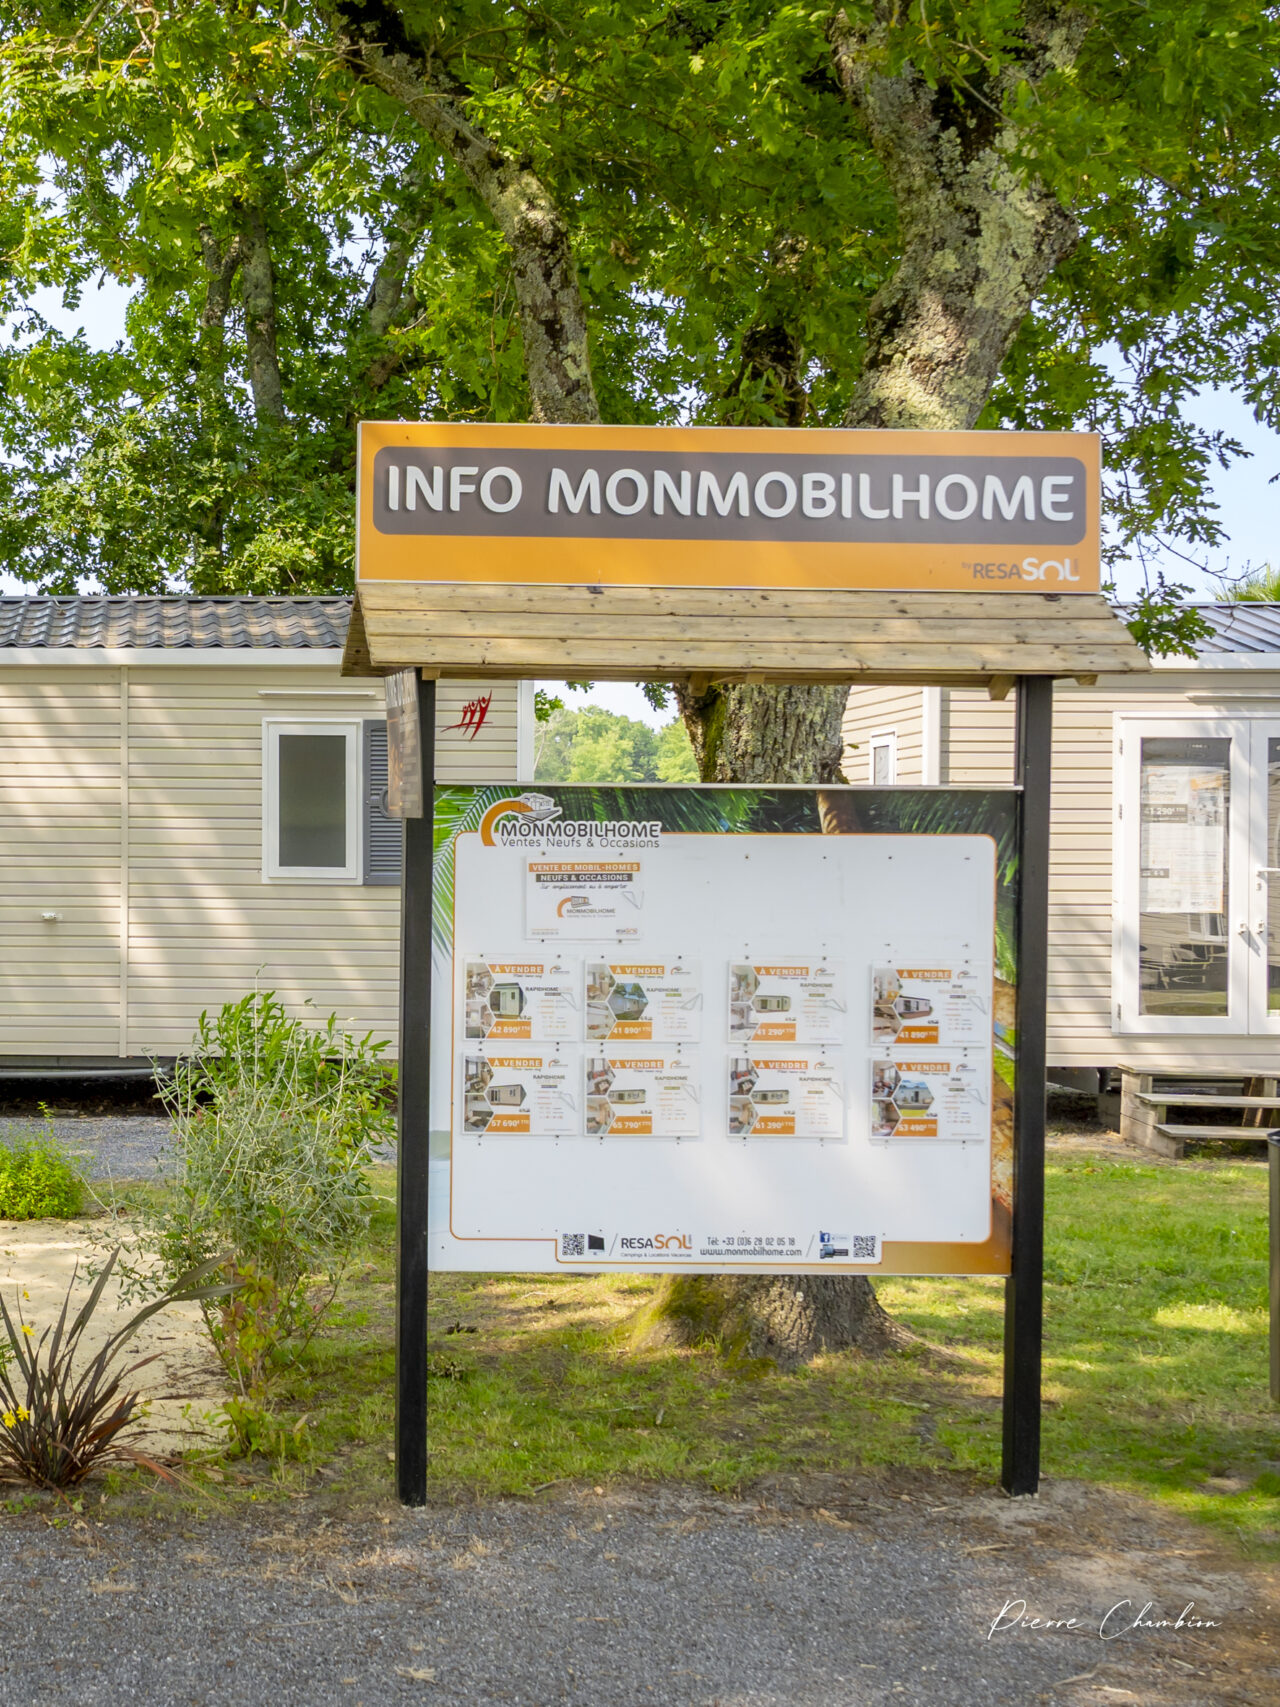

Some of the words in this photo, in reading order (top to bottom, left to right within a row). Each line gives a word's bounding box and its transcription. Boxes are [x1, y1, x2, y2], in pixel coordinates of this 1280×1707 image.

[387, 465, 523, 514] INFO
[546, 468, 1075, 522] MONMOBILHOME
[501, 822, 661, 838] MONMOBILHOME
[500, 837, 541, 847] Ventes
[546, 837, 581, 847] Neufs
[587, 838, 594, 848] &
[600, 838, 660, 848] Occasions
[754, 1238, 762, 1246] 28
[765, 1238, 774, 1246] 02
[777, 1238, 785, 1246] 05
[788, 1238, 795, 1246] 18
[700, 1248, 802, 1257] www.monmobilhome.com
